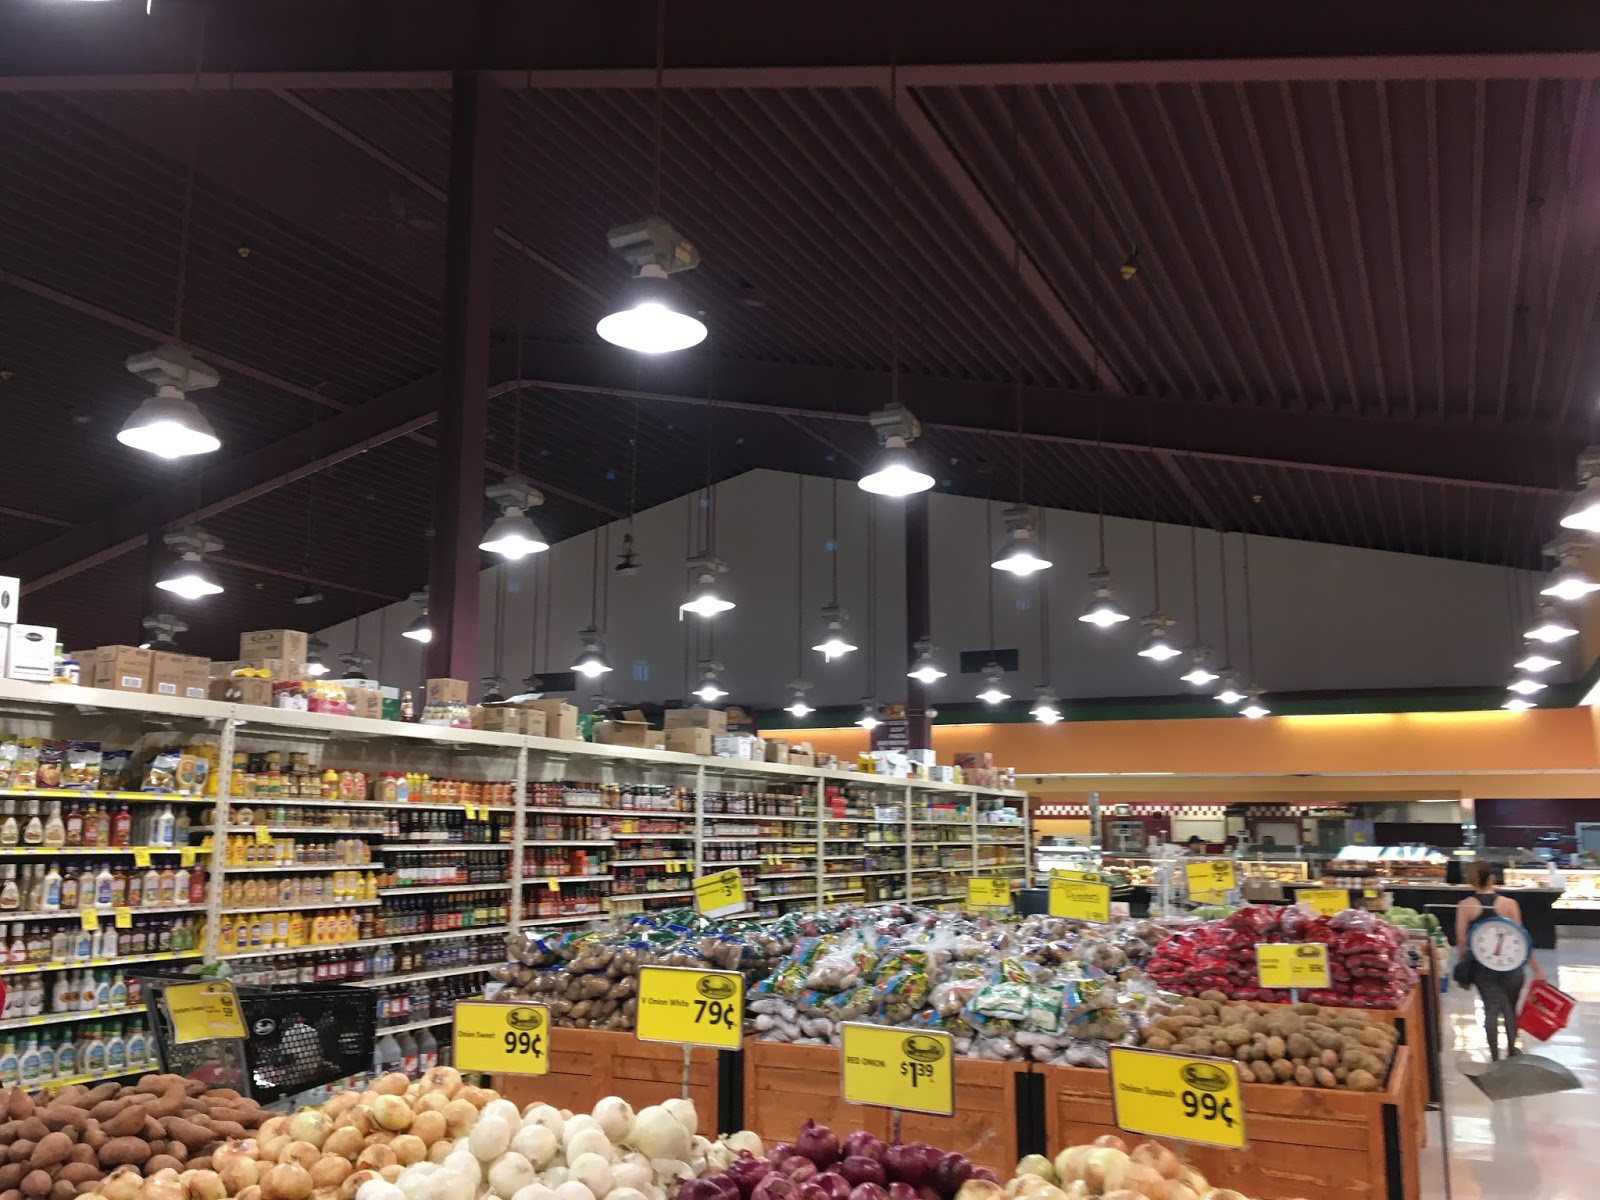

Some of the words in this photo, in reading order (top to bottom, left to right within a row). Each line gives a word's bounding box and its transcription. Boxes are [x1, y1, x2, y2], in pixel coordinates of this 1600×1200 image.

[648, 997, 669, 1006] Onion
[693, 999, 735, 1030] 79¢
[504, 1031, 542, 1058] 99¢
[861, 1057, 886, 1068] ONION
[1181, 1090, 1234, 1128] 99¢
